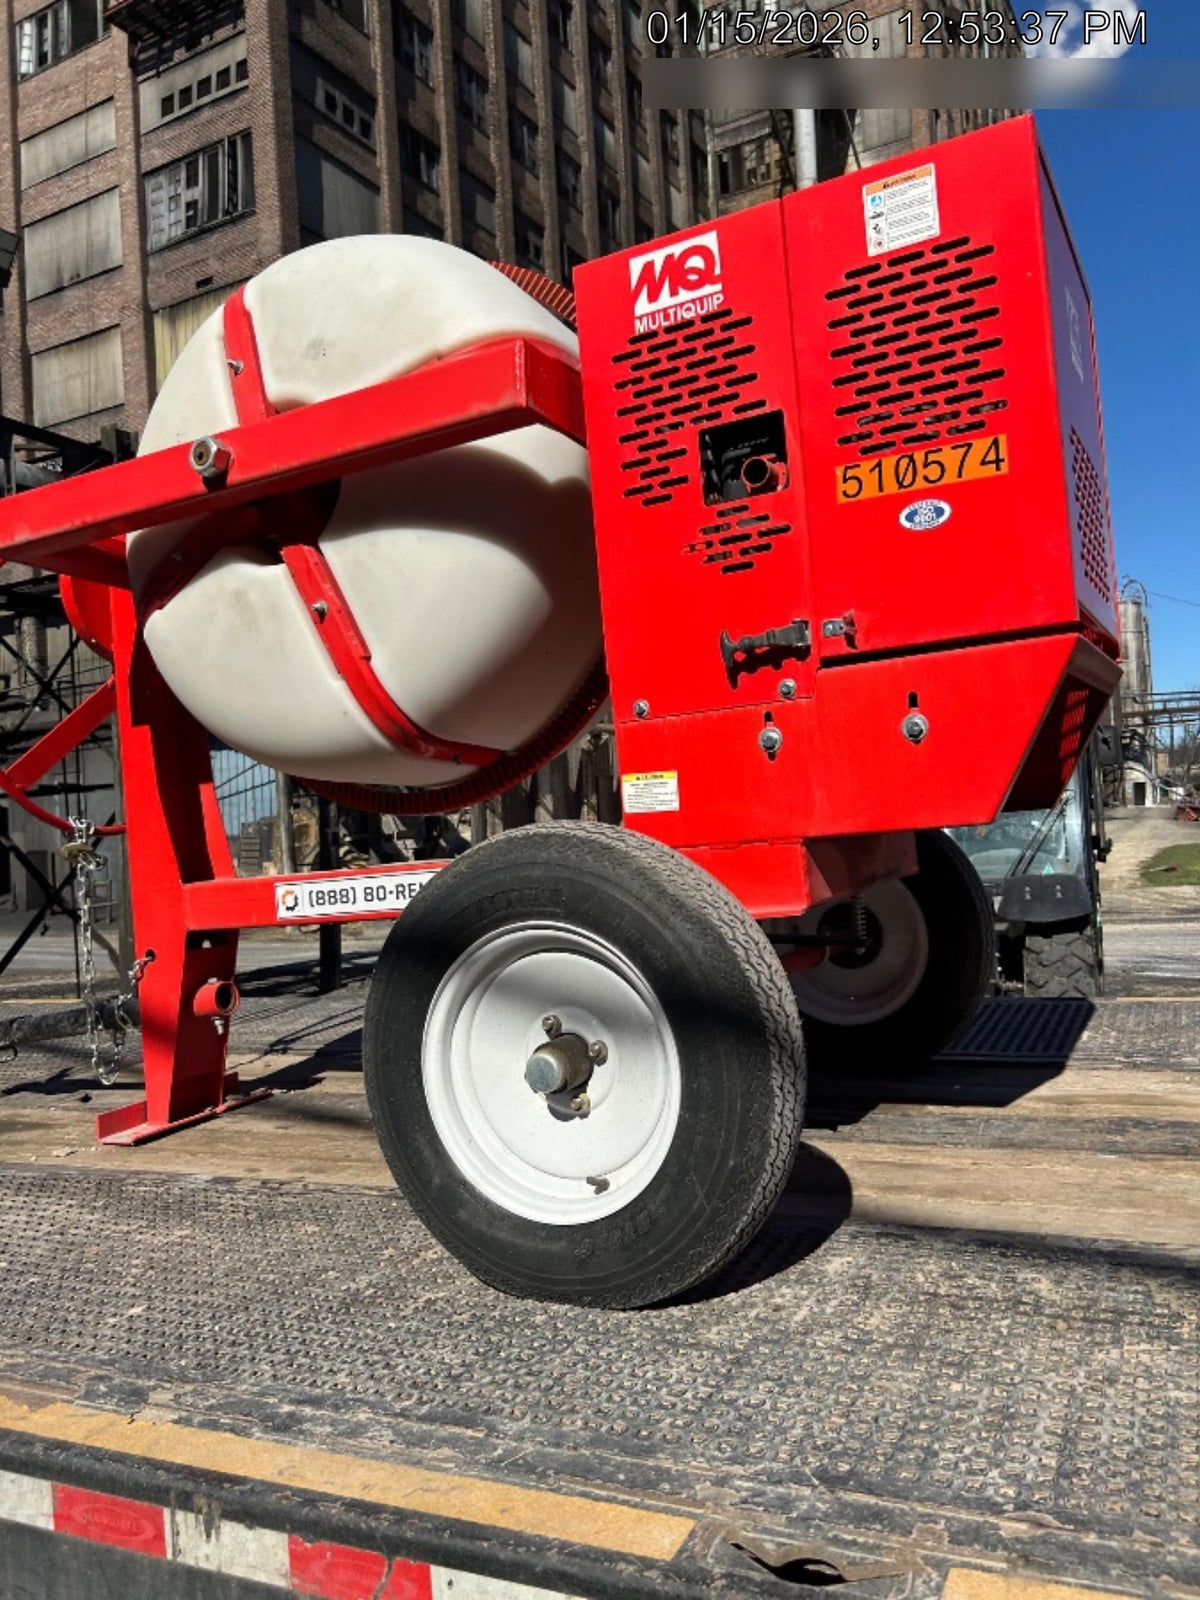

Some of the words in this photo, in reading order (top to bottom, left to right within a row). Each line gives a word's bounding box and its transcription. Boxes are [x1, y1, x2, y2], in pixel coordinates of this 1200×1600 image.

[630, 242, 721, 305] MQ
[634, 293, 724, 335] MULTIQUIP
[841, 436, 1006, 499] 510574
[308, 887, 356, 907] (888)
